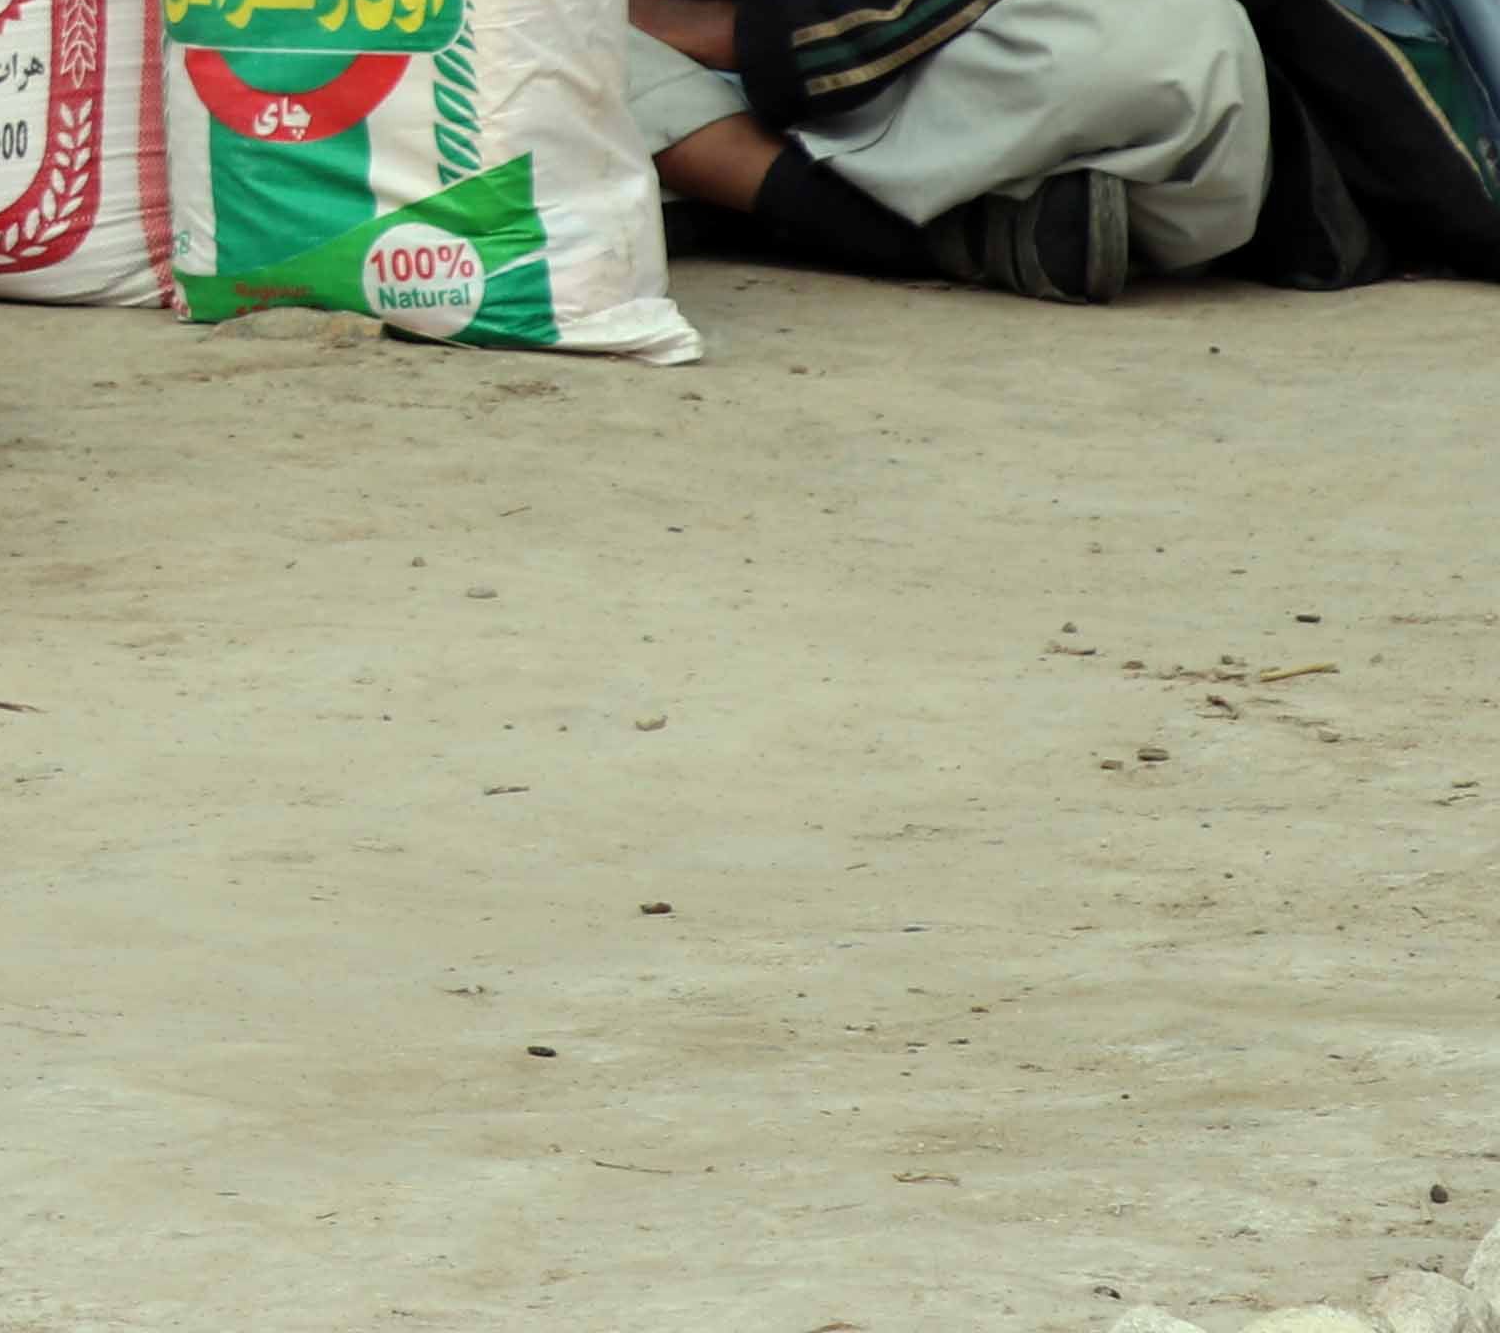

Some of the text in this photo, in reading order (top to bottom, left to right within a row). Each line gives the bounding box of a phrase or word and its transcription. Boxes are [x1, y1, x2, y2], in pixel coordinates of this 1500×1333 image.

[251, 95, 315, 140] چای
[368, 242, 477, 285] 100%
[375, 281, 473, 312] Natural
